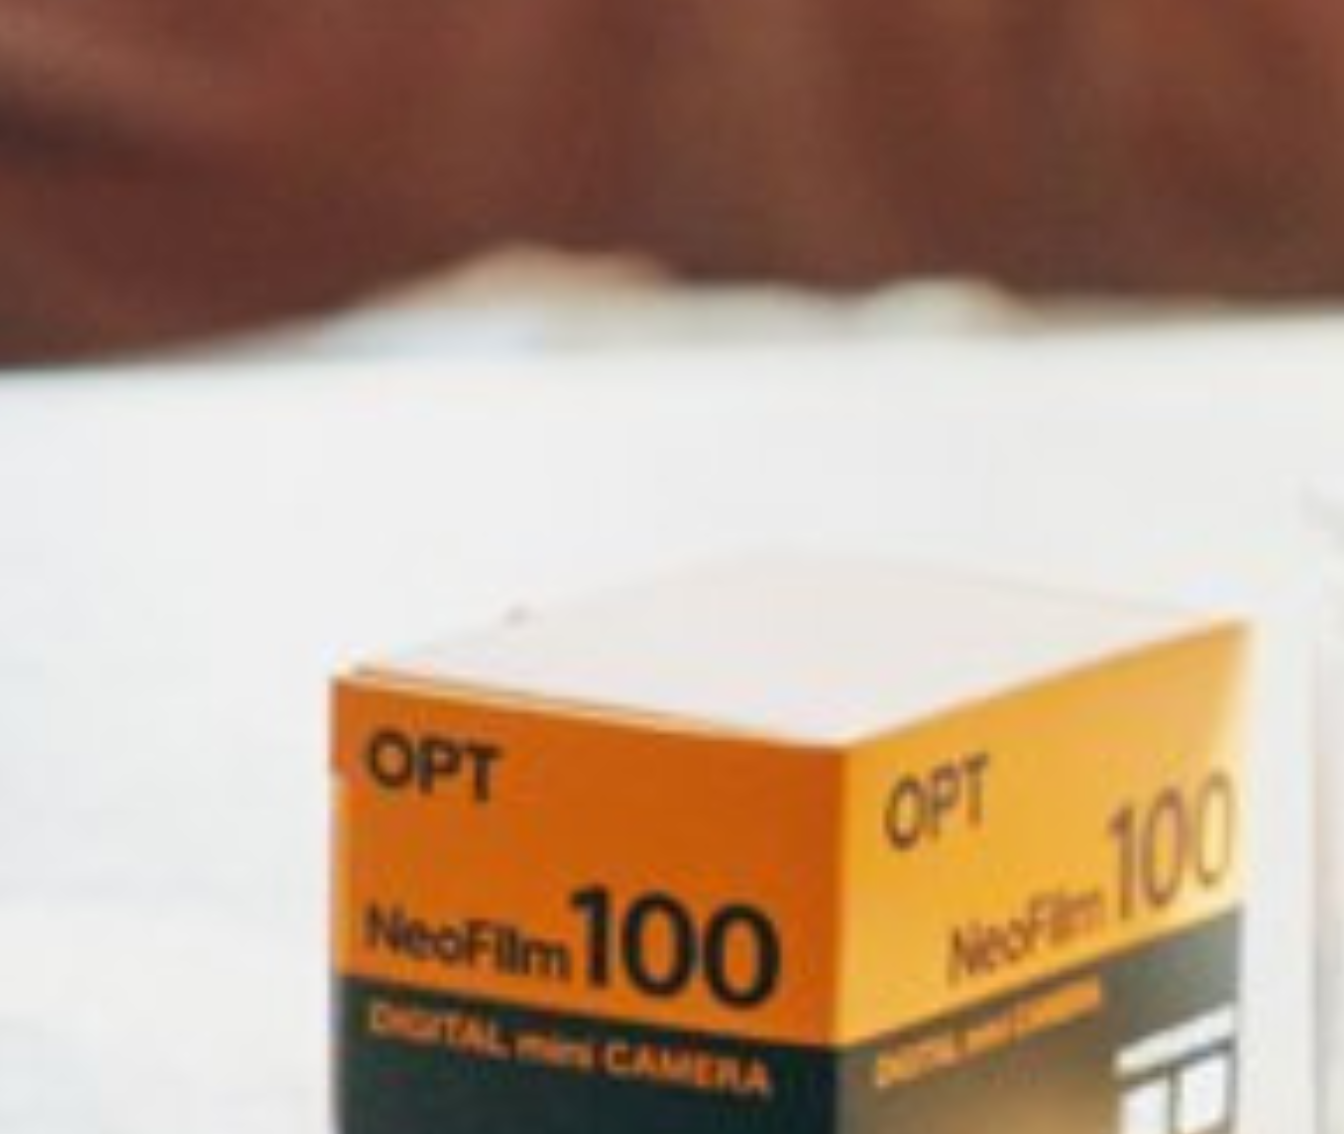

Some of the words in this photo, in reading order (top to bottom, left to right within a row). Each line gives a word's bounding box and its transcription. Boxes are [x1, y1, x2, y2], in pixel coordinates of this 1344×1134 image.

[365, 729, 503, 803] OPT
[883, 751, 990, 850] OPT
[605, 1038, 774, 1098] CAMERA
